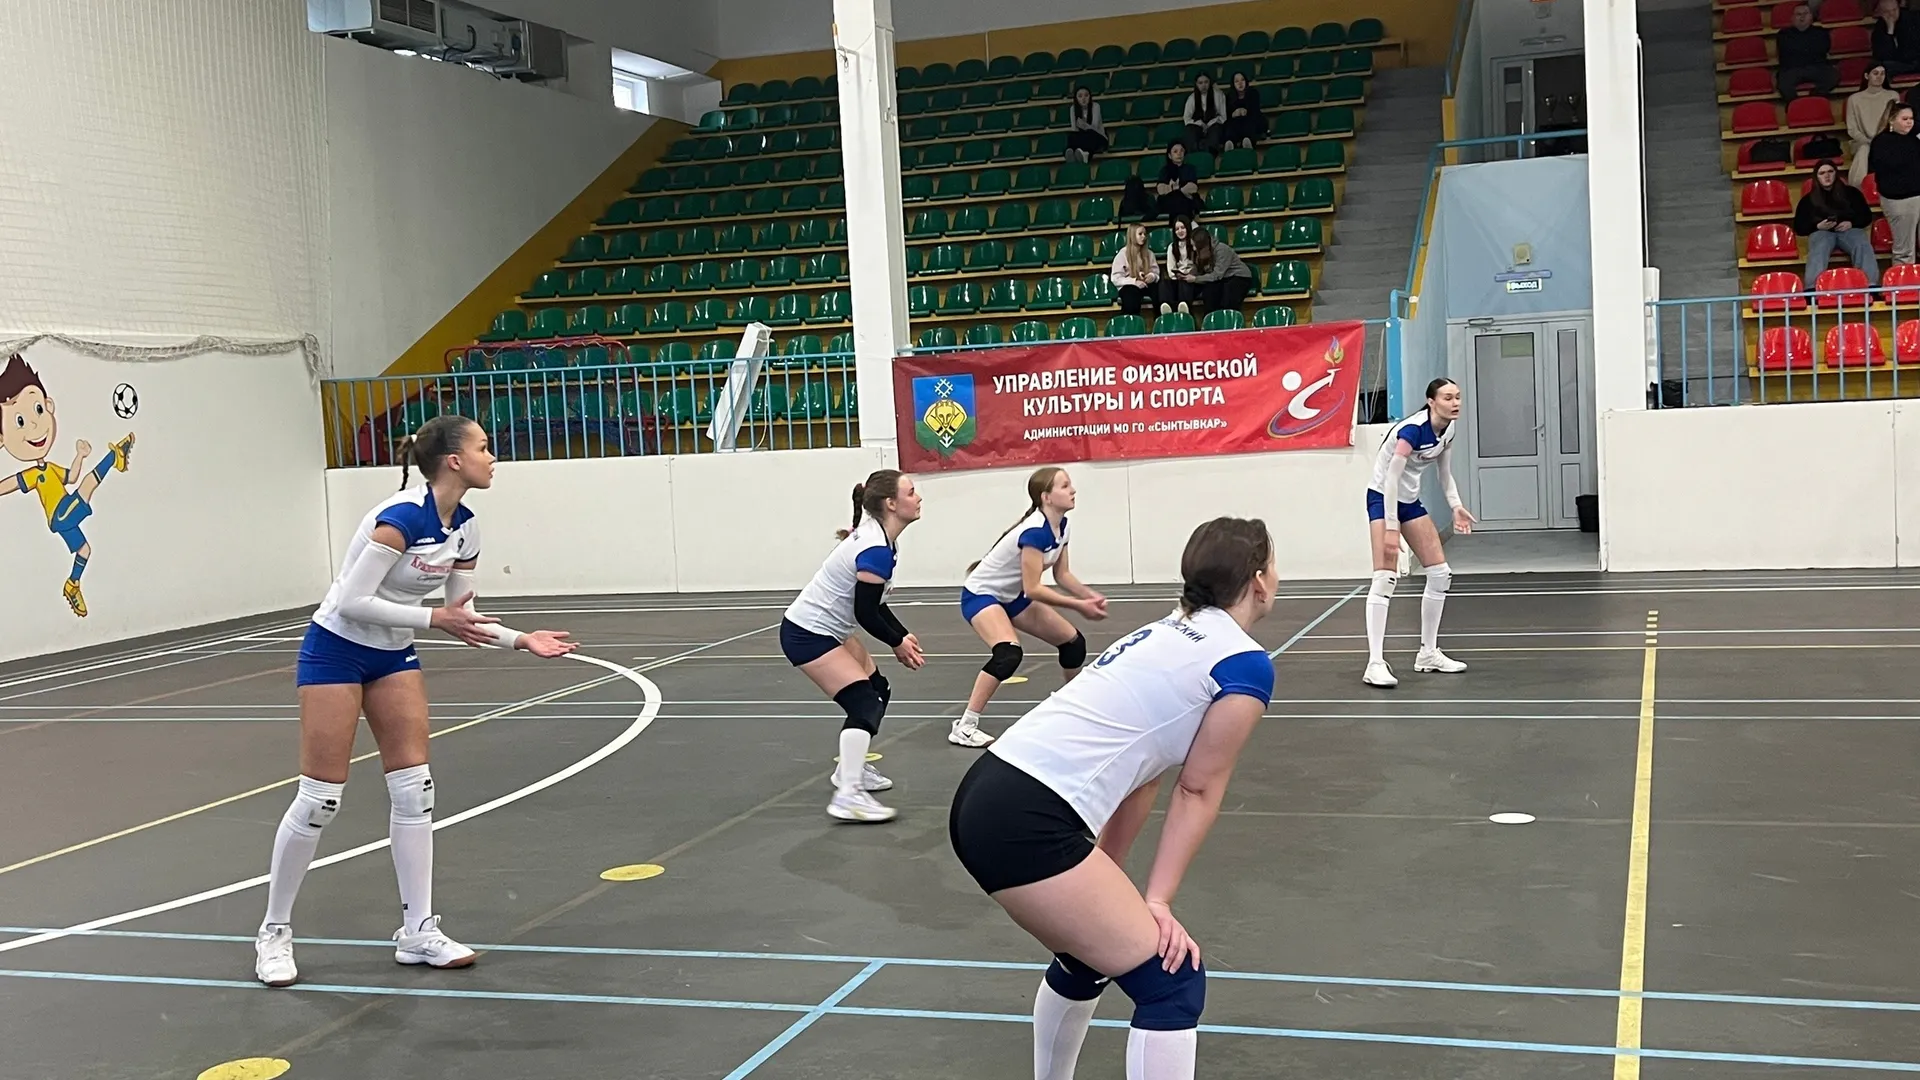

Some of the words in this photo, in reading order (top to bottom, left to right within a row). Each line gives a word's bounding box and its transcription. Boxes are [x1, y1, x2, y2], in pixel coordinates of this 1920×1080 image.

[993, 366, 1117, 395] УПРАВЛЕНИЕ
[1122, 353, 1258, 385] ФИЗИЧЕСКОЙ
[1023, 391, 1124, 417] КУЛЬТУРЫ
[1130, 390, 1144, 410] И
[1150, 386, 1225, 409] СПОРТА
[1023, 423, 1111, 440] АДМИНИСТРАЦИИ
[1113, 422, 1129, 434] МО
[1131, 421, 1145, 433] ГО
[1148, 418, 1227, 433] «СЫКТЫВКАР»
